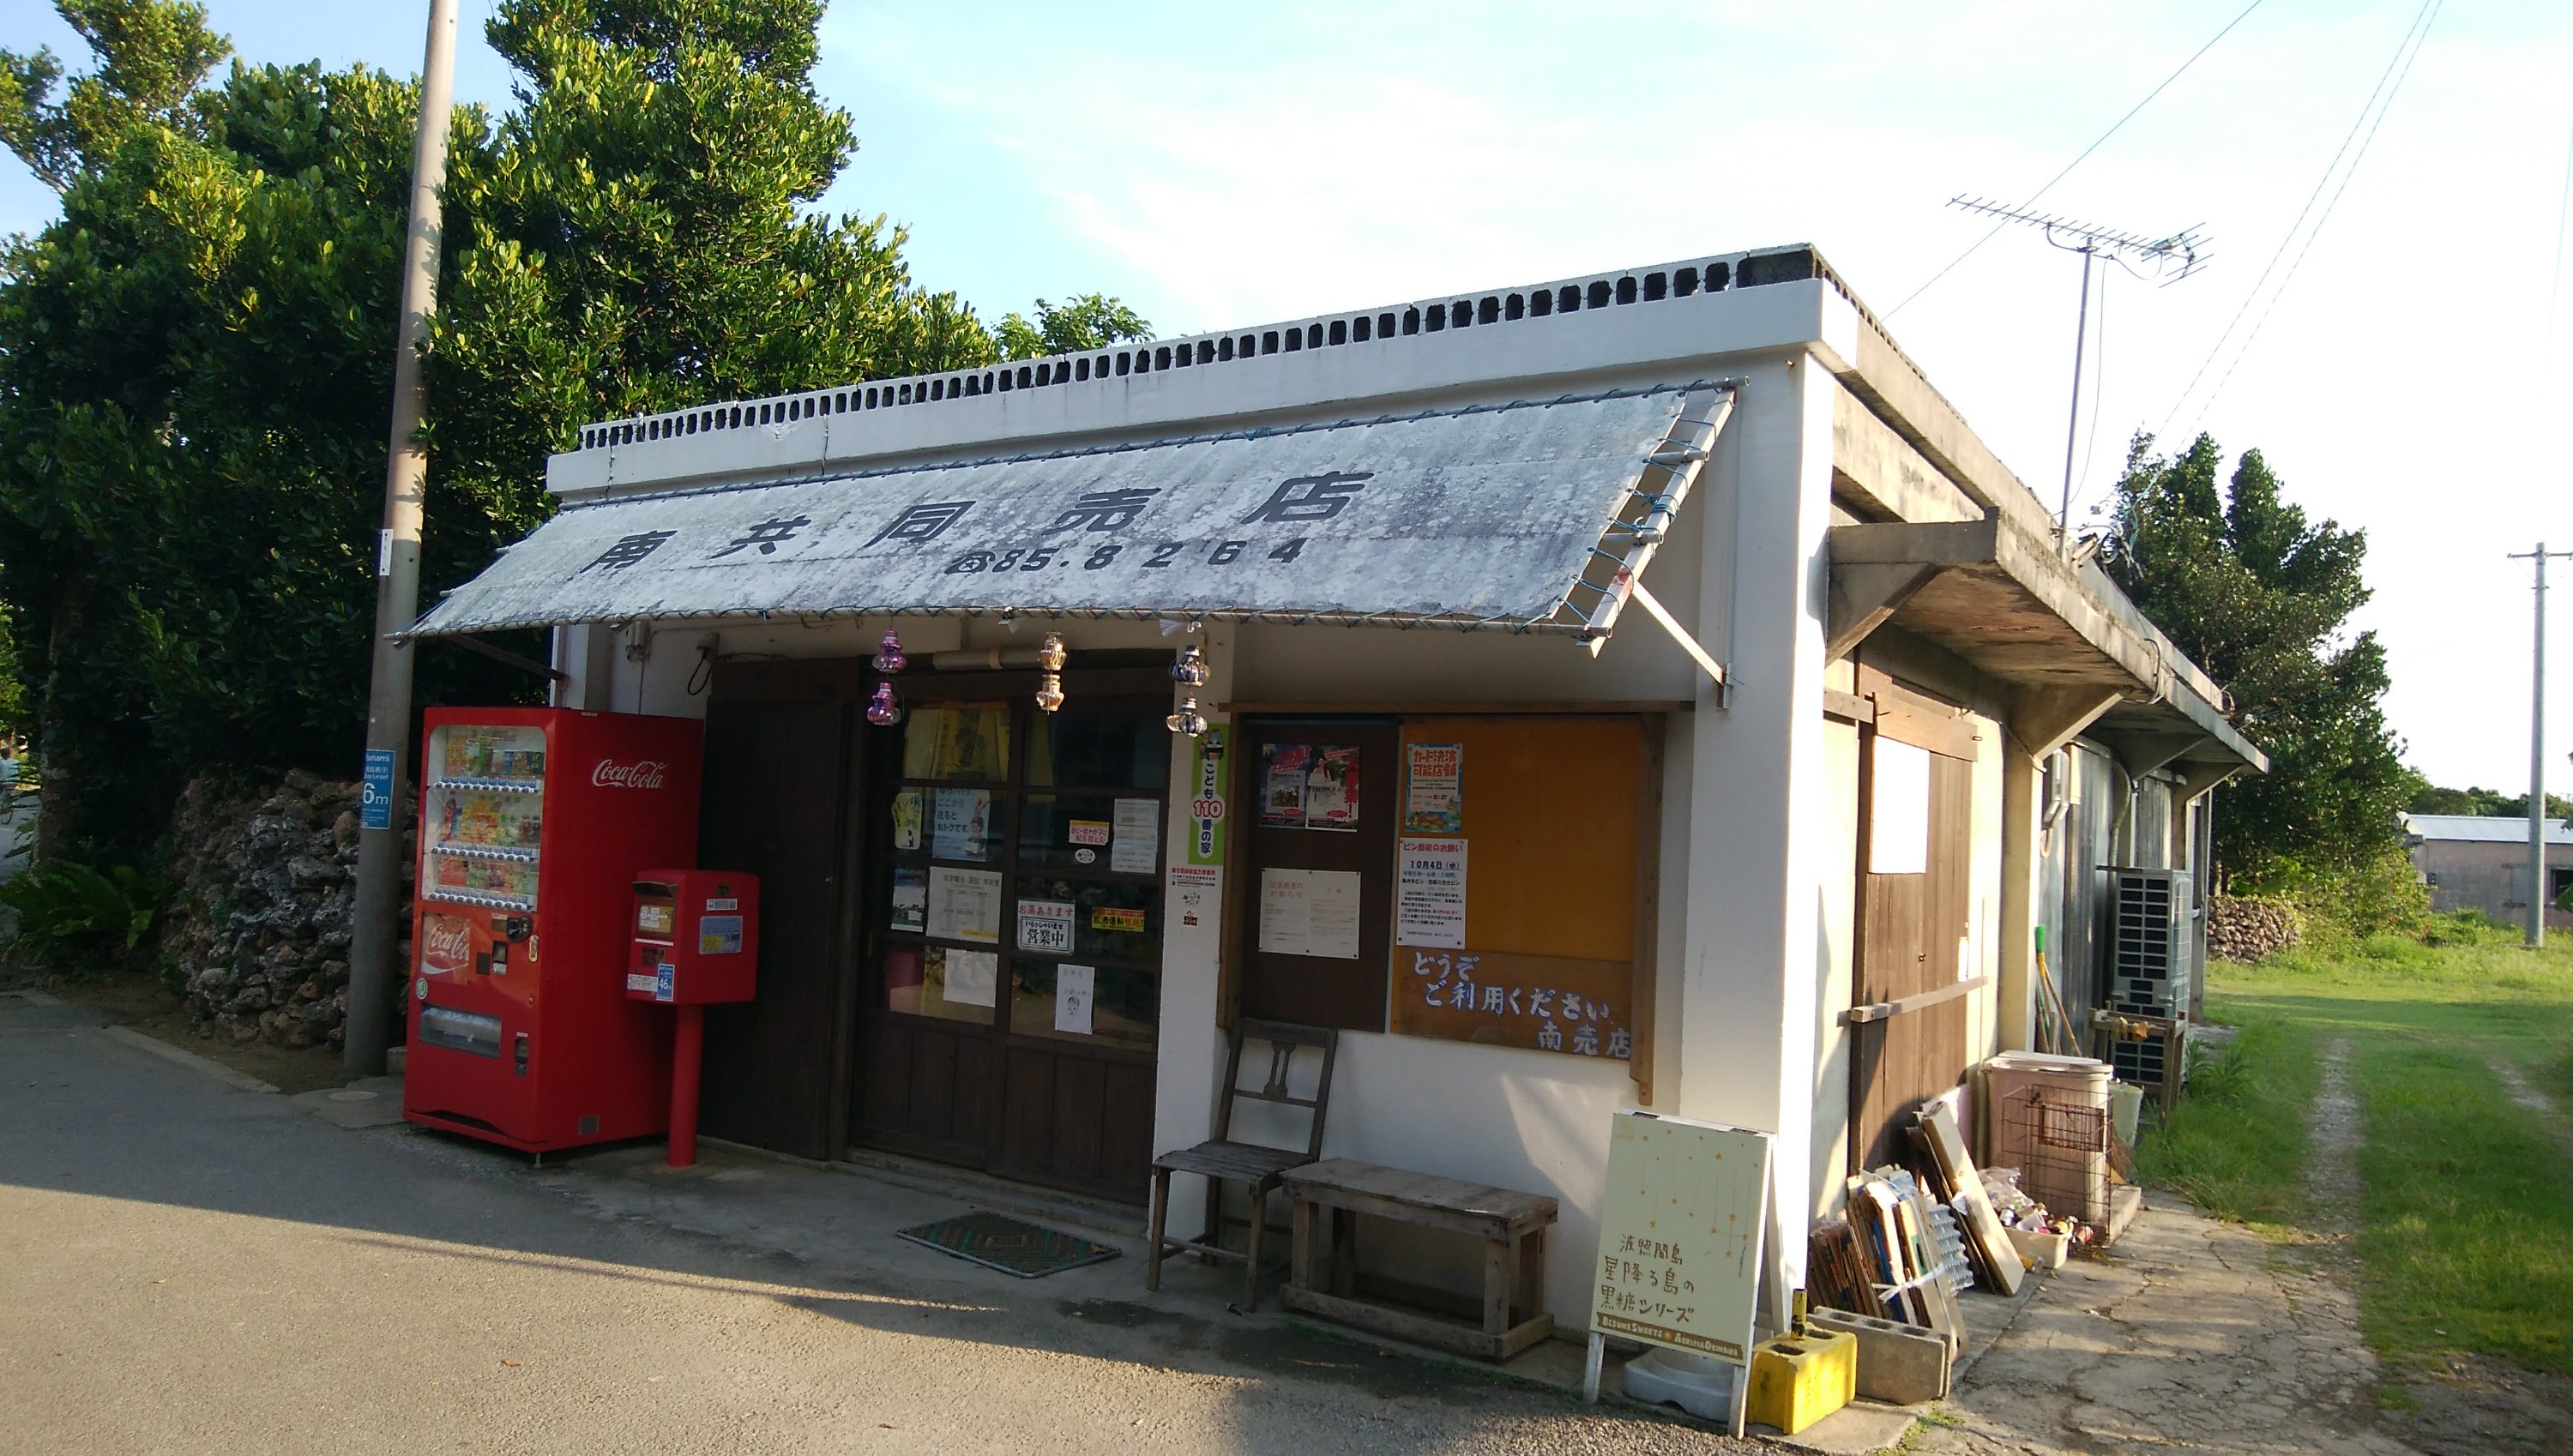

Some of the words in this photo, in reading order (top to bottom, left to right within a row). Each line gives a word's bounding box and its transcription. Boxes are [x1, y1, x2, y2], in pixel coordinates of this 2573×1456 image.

[579, 470, 1373, 574] 南共同売店
[365, 753, 390, 762] sunami
[1413, 749, 1457, 762] カード決済
[1413, 763, 1457, 777] 可能店舗
[592, 759, 667, 789] Coca-Cola
[1025, 921, 1064, 930] いらっしゃいませ
[1027, 929, 1064, 947] 営業中
[1414, 951, 1480, 982] どうぞ
[1426, 979, 1610, 1021] ご利用ください
[1538, 1020, 1630, 1058] 南売店
[1619, 1233, 1683, 1266] 波照間島
[1605, 1255, 1695, 1296] 星降る島の
[1600, 1285, 1695, 1323] 黒糖シリーズ
